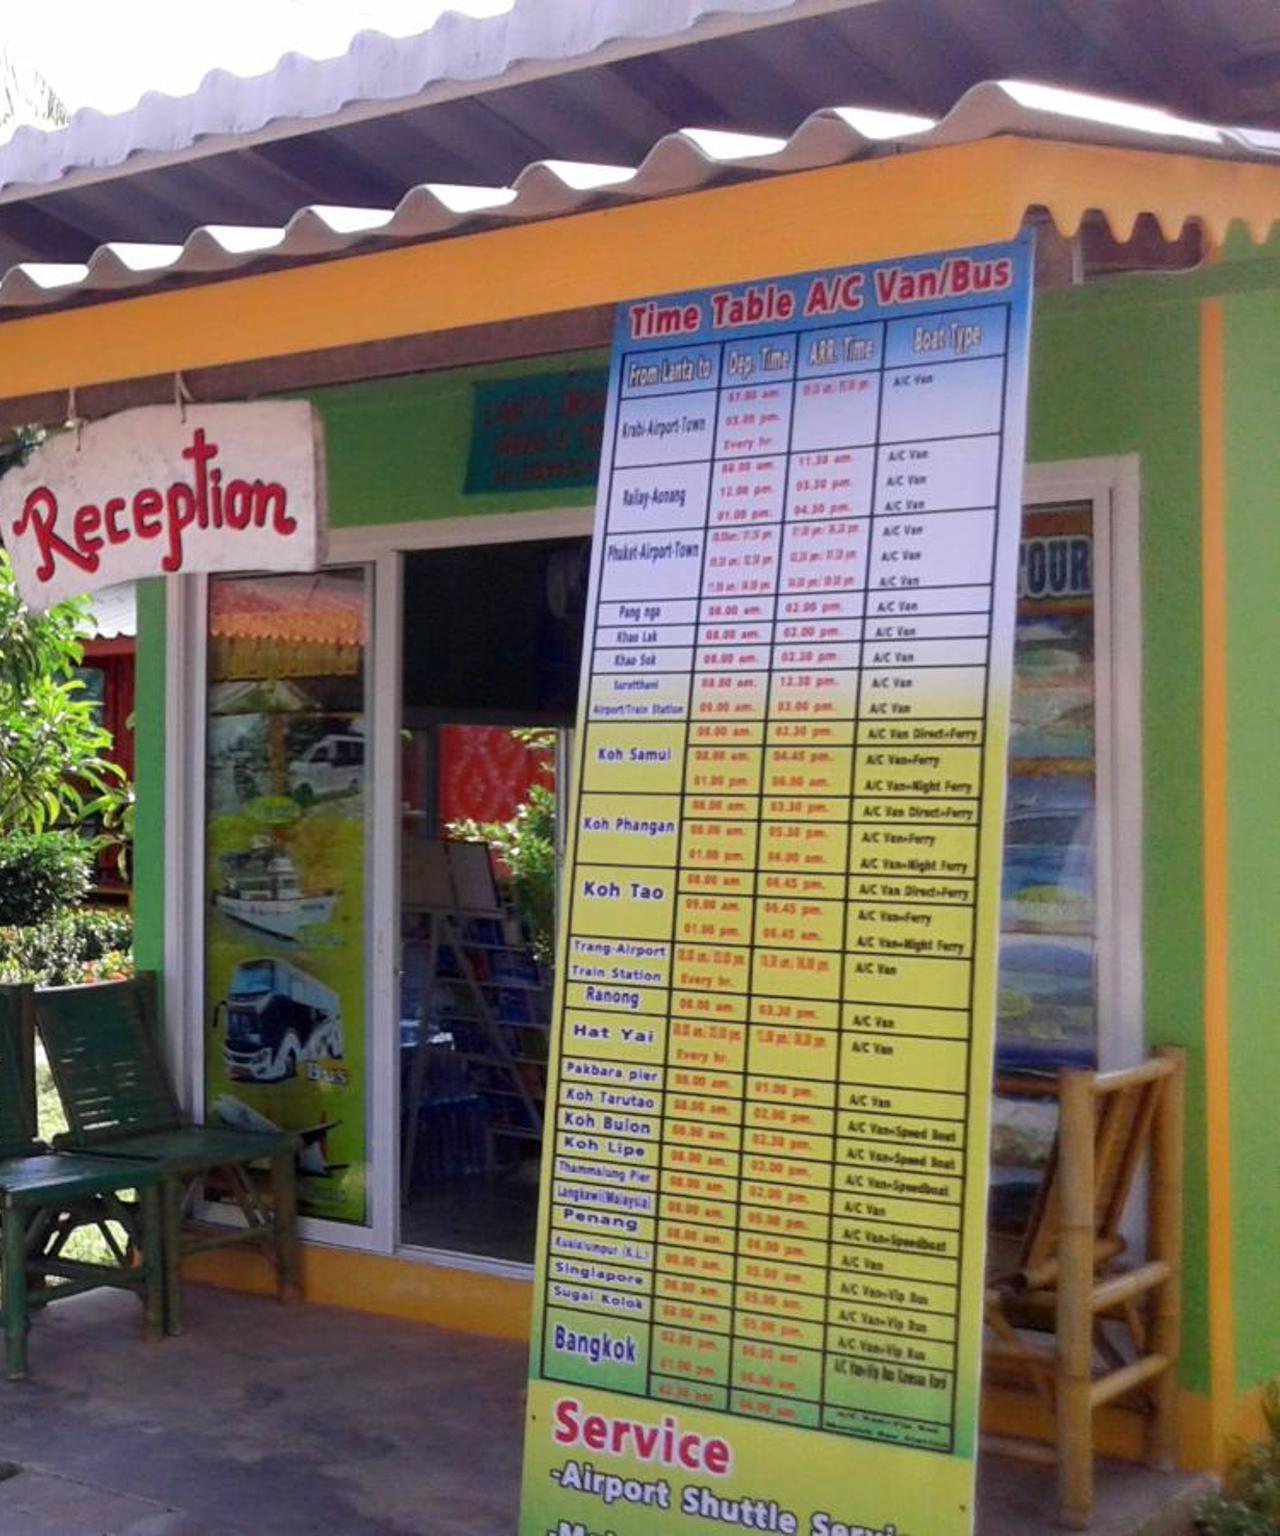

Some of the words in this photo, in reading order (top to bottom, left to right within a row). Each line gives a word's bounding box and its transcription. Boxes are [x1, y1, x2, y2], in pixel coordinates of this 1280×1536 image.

[631, 303, 700, 338] Time
[713, 286, 792, 328] Table
[803, 273, 863, 315] A/C
[877, 258, 1011, 302] Van/Bus
[913, 322, 946, 353] Boat
[948, 317, 984, 354] Type
[841, 332, 874, 362] Time
[758, 341, 790, 372] Time
[629, 357, 661, 388] From
[661, 353, 695, 384] Lanta
[696, 354, 712, 380] to
[893, 375, 911, 387] A/C
[914, 374, 933, 384] Van
[888, 450, 905, 462] A/C
[909, 450, 929, 460] Van
[12, 428, 297, 583] Reception
[882, 525, 901, 536] A/C
[904, 525, 924, 534] Van
[618, 605, 641, 622] Pang
[877, 600, 895, 612] A/C
[898, 601, 918, 611] Van
[616, 631, 639, 643] Khao
[642, 630, 658, 643] Lak
[875, 626, 893, 637] A/C
[897, 626, 916, 636] Van
[614, 654, 637, 667] Khao
[639, 653, 657, 666] Sok
[872, 651, 891, 663] A/C
[894, 652, 914, 663] Van
[869, 702, 887, 714] A/C
[891, 703, 911, 714] Van
[867, 728, 886, 740] A/C
[890, 729, 909, 740] Van
[598, 748, 624, 761] Koh
[866, 754, 884, 765] A/C
[864, 779, 883, 791] A/C
[944, 780, 973, 794] Ferry
[583, 817, 610, 830] Koh
[615, 817, 675, 836] Phangan
[583, 881, 620, 897] Koh
[631, 883, 664, 900] Tao
[859, 884, 877, 895] A/C
[572, 964, 605, 977] Train
[611, 967, 661, 982] Station
[855, 962, 874, 974] A/C
[877, 964, 897, 975] Van
[586, 985, 639, 1009] Ranong
[852, 1015, 871, 1027] A/C
[875, 1016, 895, 1029] Van
[573, 1024, 609, 1039] Hat
[621, 1028, 654, 1042] Yai
[567, 1061, 623, 1078] Pakbara
[629, 1070, 658, 1081] pier
[566, 1088, 593, 1102] Koh
[600, 1091, 655, 1109] Tarutao
[564, 1111, 595, 1128] Koh
[847, 1120, 866, 1134] A/C
[564, 1136, 599, 1151] Koh
[608, 1141, 645, 1158] Lipe
[630, 1169, 650, 1183] Pier
[563, 1207, 640, 1232] Penang
[553, 1285, 594, 1302] Sugai
[554, 1325, 635, 1363] Bangkok
[553, 1400, 730, 1474] Service
[681, 1487, 798, 1535] Shuttle
